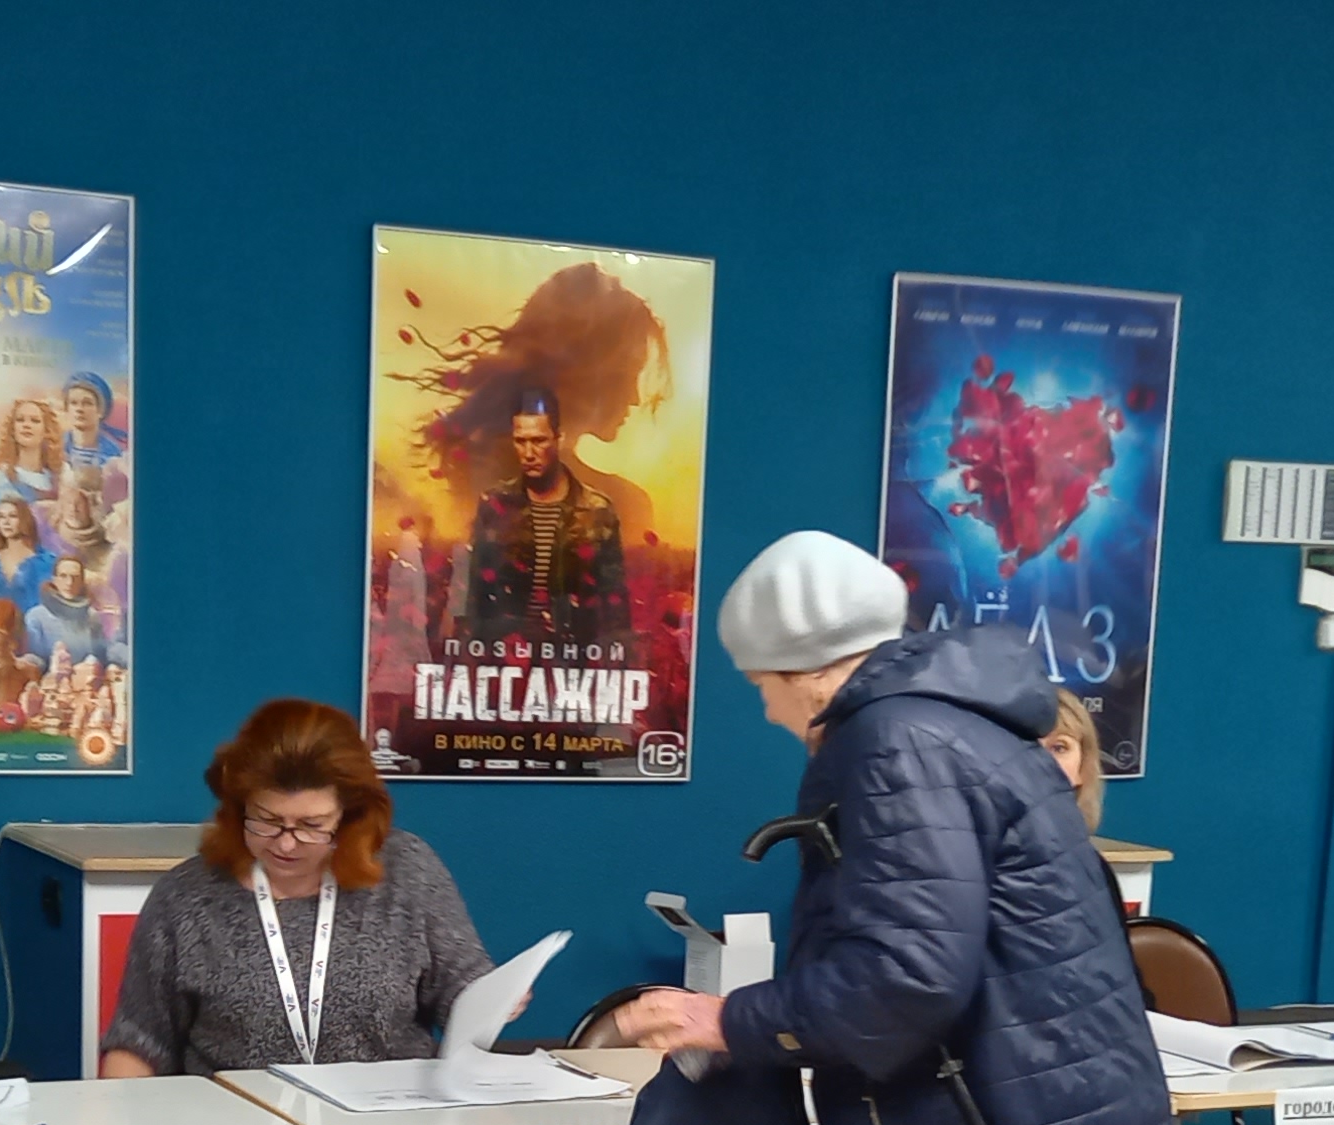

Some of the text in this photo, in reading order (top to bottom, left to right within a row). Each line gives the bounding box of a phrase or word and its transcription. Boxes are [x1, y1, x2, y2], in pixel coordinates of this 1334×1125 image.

[444, 638, 624, 661] ПОЗЫВНОЙ
[1077, 604, 1116, 683] 3
[414, 663, 650, 724] ПАССАЖИР
[434, 732, 624, 752] В КИНО С 14 МАРТА
[646, 743, 686, 767] 16+
